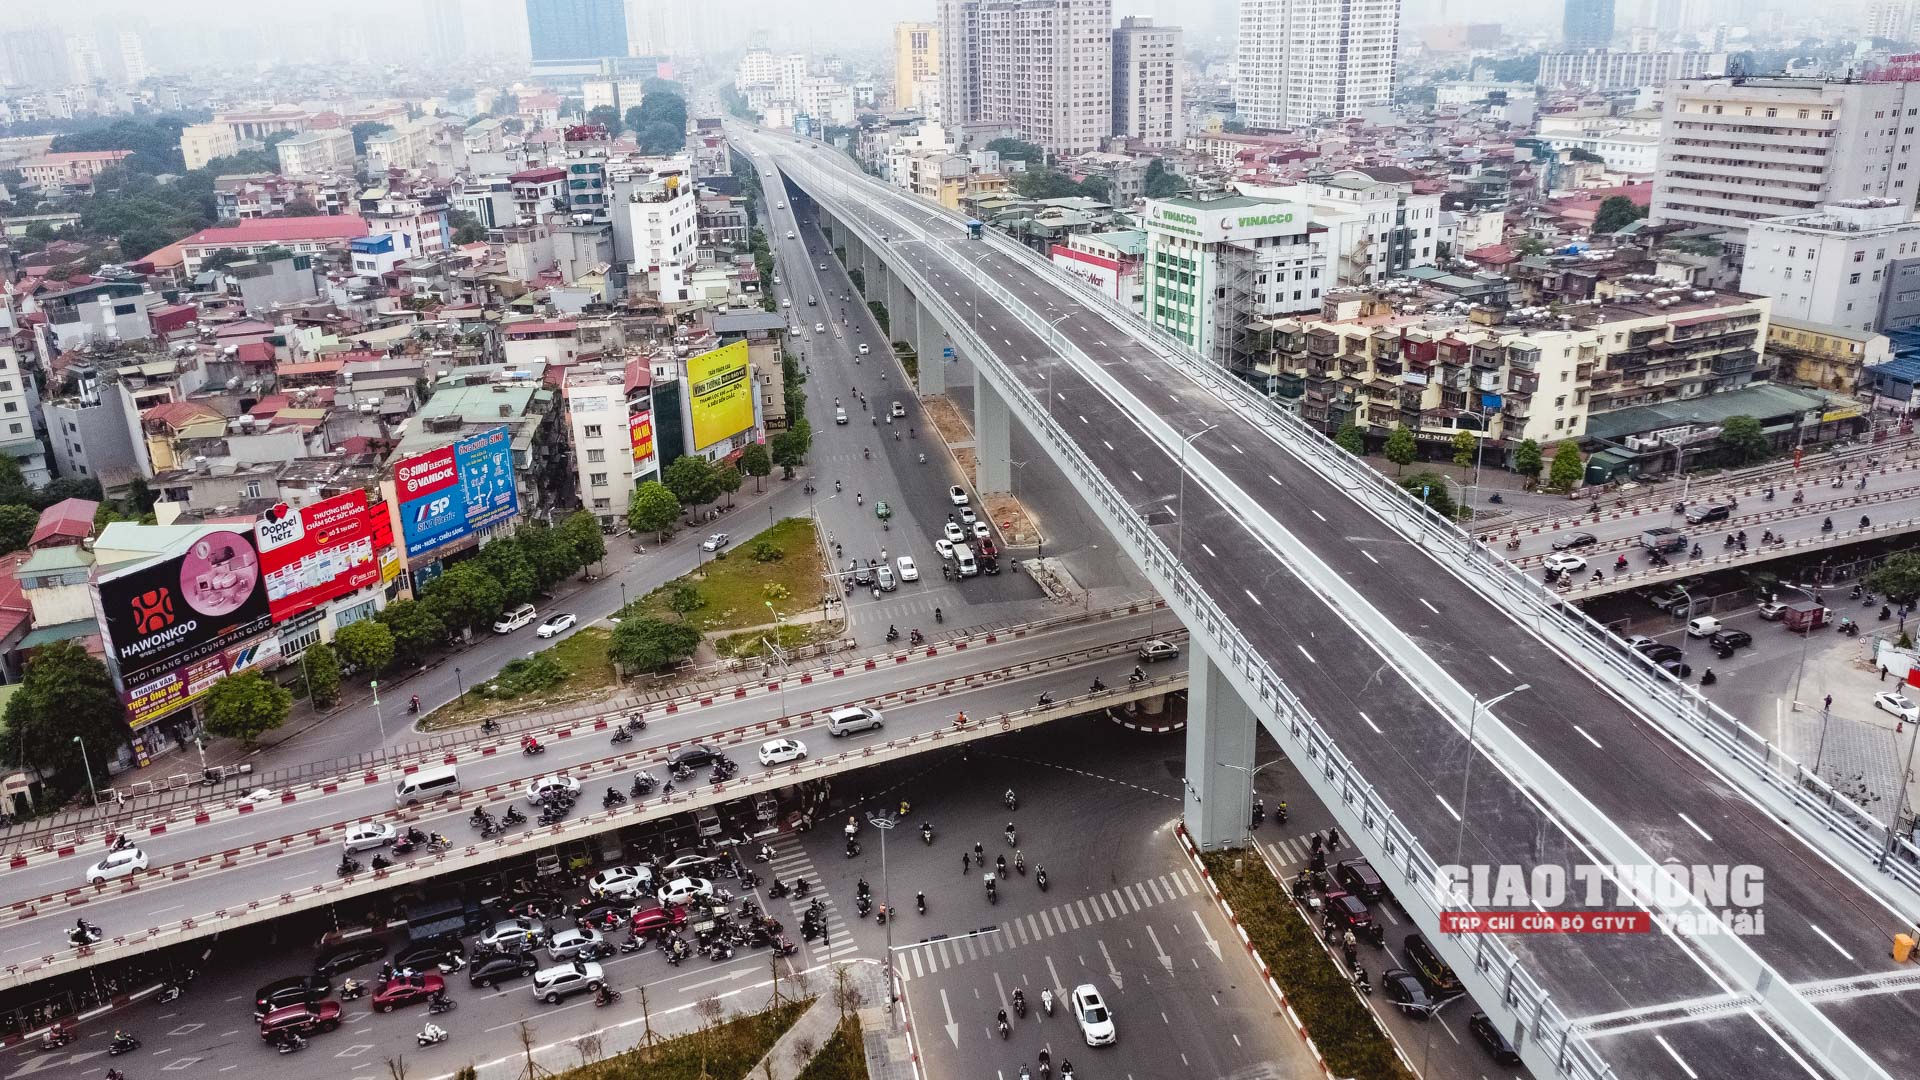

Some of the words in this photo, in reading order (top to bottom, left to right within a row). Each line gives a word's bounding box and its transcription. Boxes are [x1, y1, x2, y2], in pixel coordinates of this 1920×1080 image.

[1163, 209, 1197, 225] VINACCO
[1238, 213, 1293, 227] VINACCO
[410, 462, 428, 477] SINO
[428, 457, 452, 470] ELECTRIC
[418, 467, 454, 487] VANLOCK
[313, 506, 340, 520] THƯƠNG
[430, 496, 449, 517] SP
[261, 515, 297, 537] Doppel
[306, 517, 324, 530] CHĂM
[324, 514, 337, 524] SÓC
[270, 529, 292, 544] herz
[121, 620, 197, 658] HAWONKOO
[128, 672, 150, 685] THỜI
[150, 658, 181, 676] TRANG
[184, 651, 200, 661] GIA
[201, 639, 226, 654] DỤNG
[227, 630, 245, 643] HÀN
[246, 621, 270, 635] QUỐC
[134, 681, 158, 697] THANH
[127, 696, 148, 711] THÉP
[150, 689, 167, 701] ỐNG
